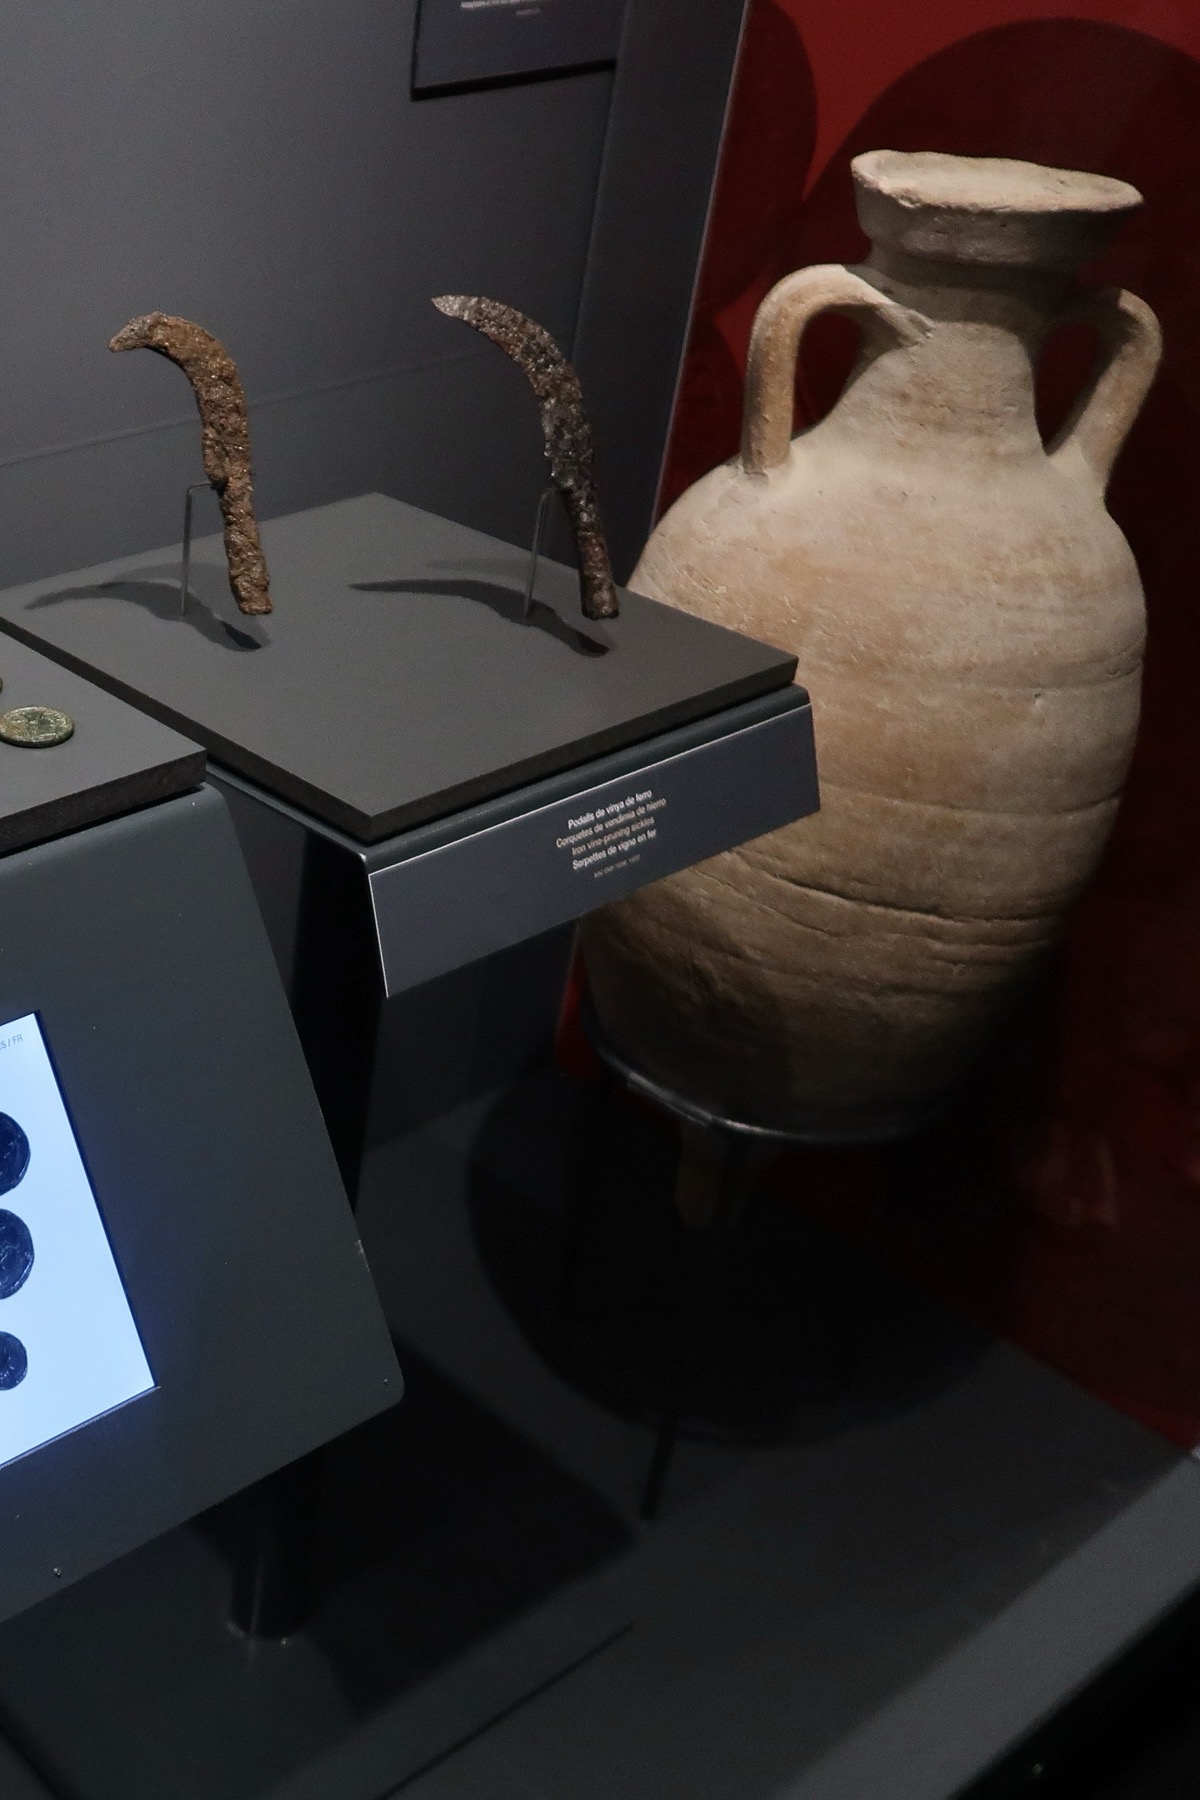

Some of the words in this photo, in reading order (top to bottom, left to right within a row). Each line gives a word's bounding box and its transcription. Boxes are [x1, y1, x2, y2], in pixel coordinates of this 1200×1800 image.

[595, 808, 606, 818] de
[606, 801, 624, 814] vinya
[625, 796, 635, 806] de
[635, 789, 653, 802] ferro
[594, 823, 604, 833] de
[636, 805, 646, 816] de
[571, 844, 587, 856] Iron
[607, 845, 617, 855] de
[637, 833, 647, 843] en
[12, 1033, 24, 1045] FR
